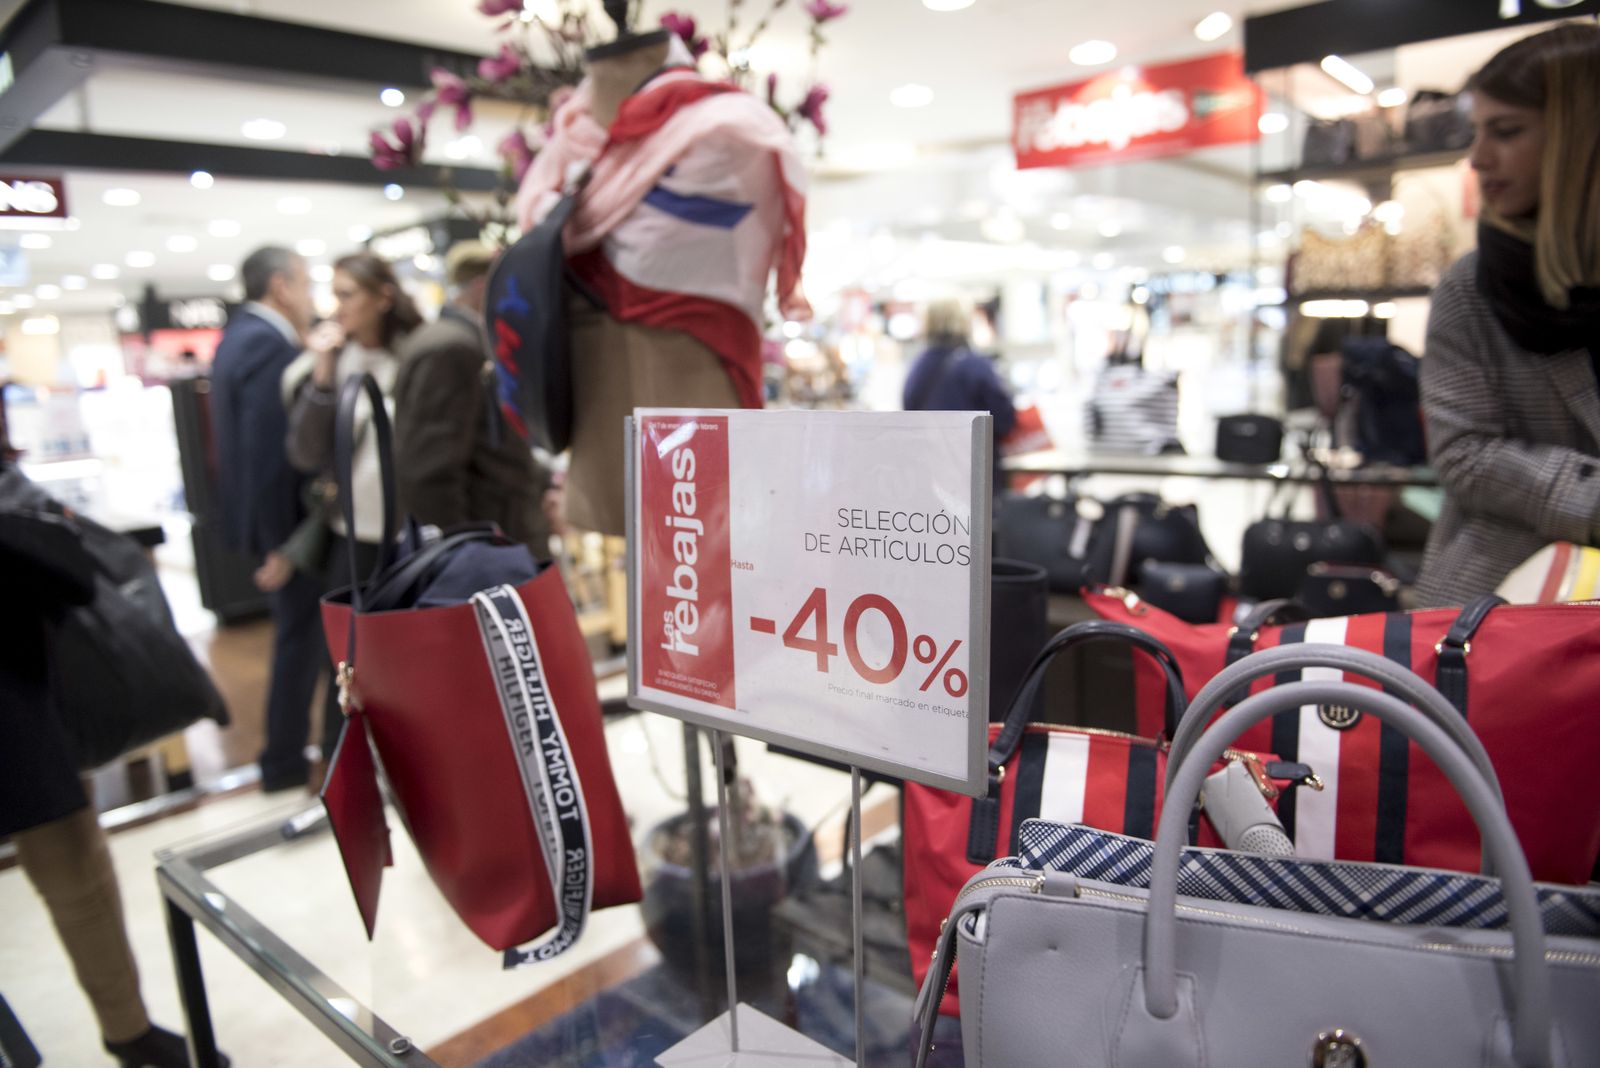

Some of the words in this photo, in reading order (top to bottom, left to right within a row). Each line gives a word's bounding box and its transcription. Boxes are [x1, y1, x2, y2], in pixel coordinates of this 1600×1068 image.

[838, 507, 970, 536] SELECCIÓN
[665, 448, 704, 656] rebajas
[804, 532, 831, 553] DE
[838, 535, 971, 566] ARTÍCULOS
[730, 559, 754, 571] Hasta
[660, 610, 674, 651] Las
[828, 683, 854, 697] Precio
[856, 688, 874, 700] final
[876, 694, 916, 709] marcado
[918, 702, 930, 711] en
